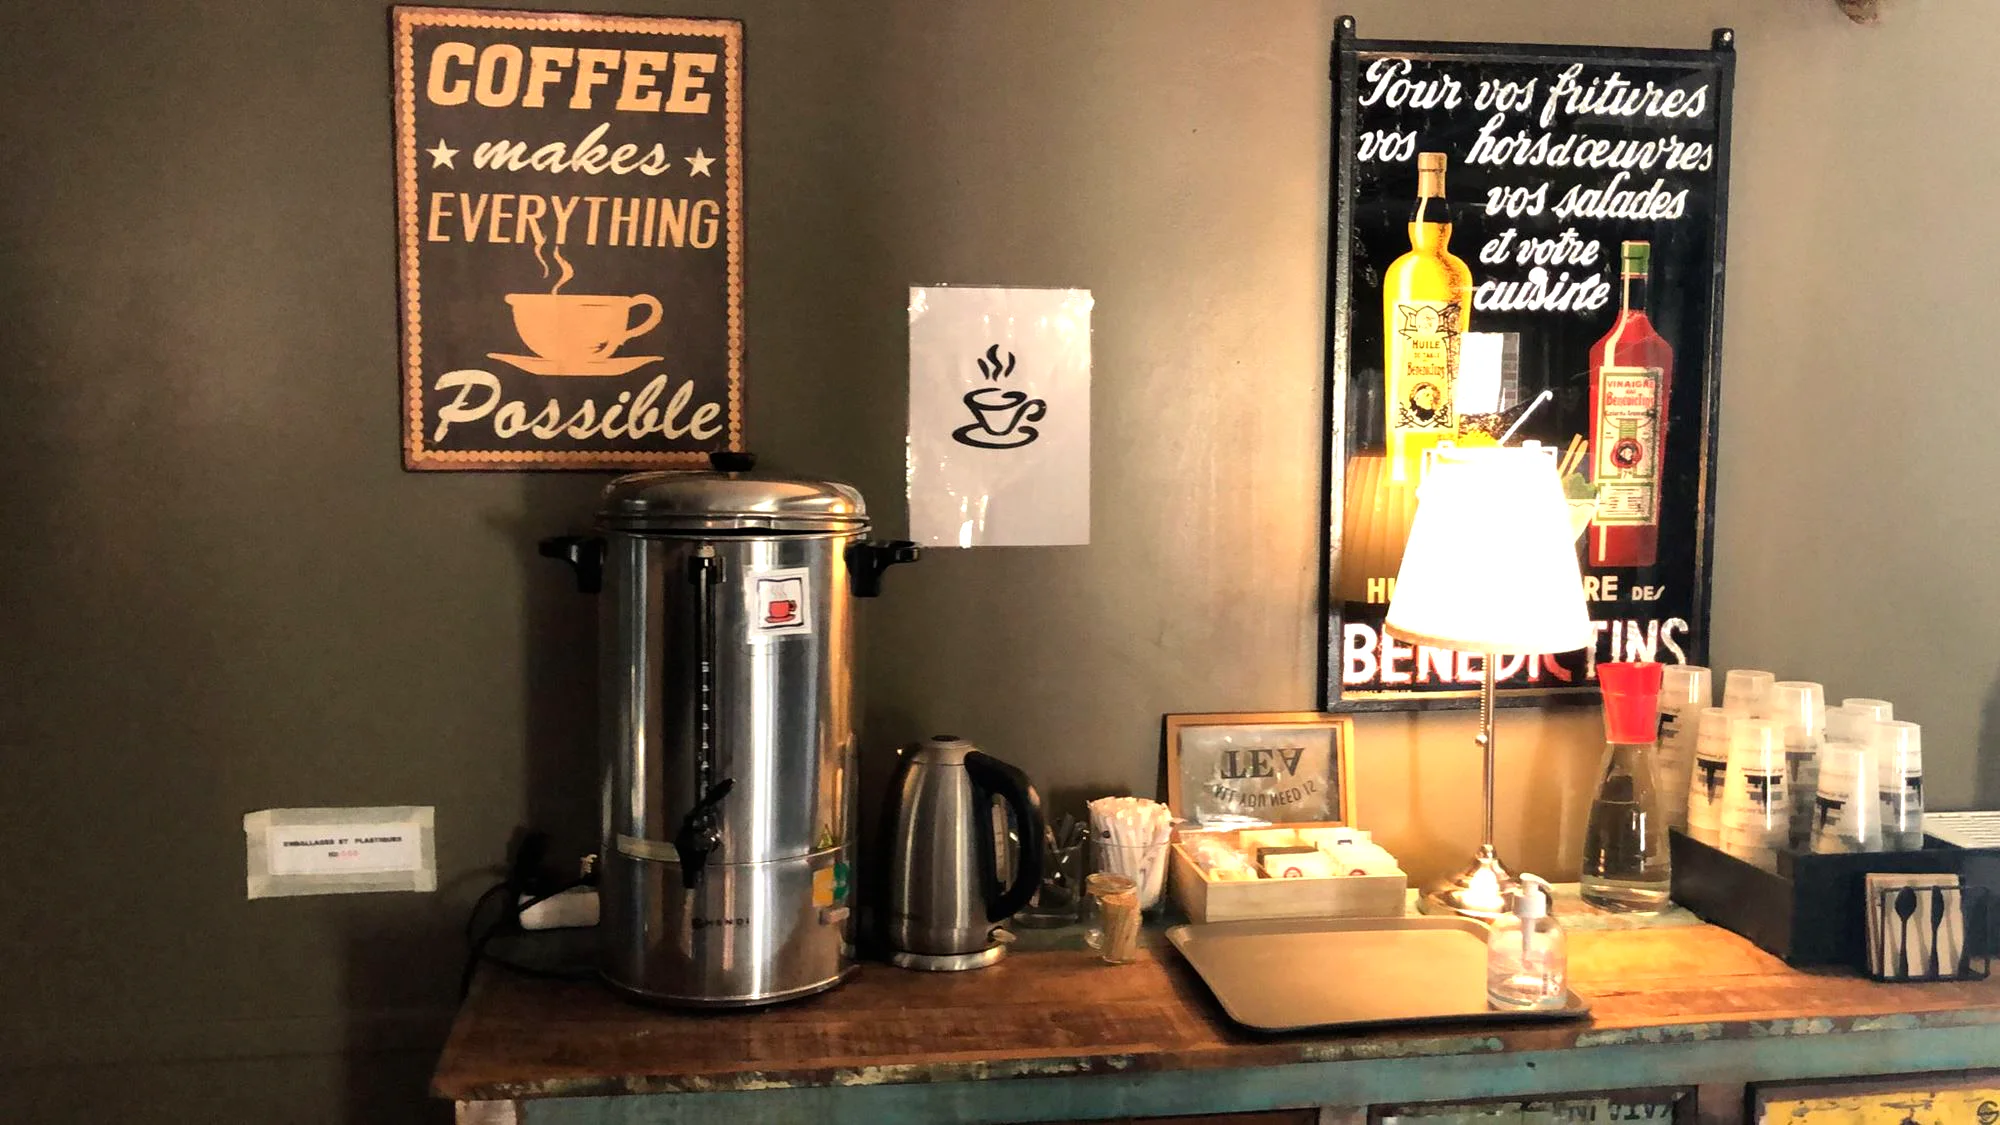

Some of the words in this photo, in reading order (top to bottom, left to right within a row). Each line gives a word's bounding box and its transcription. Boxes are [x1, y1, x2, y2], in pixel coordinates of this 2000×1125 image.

[427, 42, 717, 114] COFFEE
[1359, 57, 1462, 110] Pour
[1474, 77, 1538, 113] vos
[1540, 63, 1709, 129] fritures
[472, 121, 671, 177] makes
[1357, 129, 1419, 163] vos
[1485, 181, 1549, 218] vos
[1551, 172, 1689, 221] salades
[427, 191, 720, 249] EVERYTHING
[1479, 226, 1517, 264] et
[1517, 227, 1600, 267] votre
[1473, 269, 1611, 312] cuisine
[1412, 340, 1440, 349] HUILE
[433, 369, 724, 443] Possible
[1607, 380, 1655, 389] VINAIGRE
[1631, 585, 1665, 601] DES
